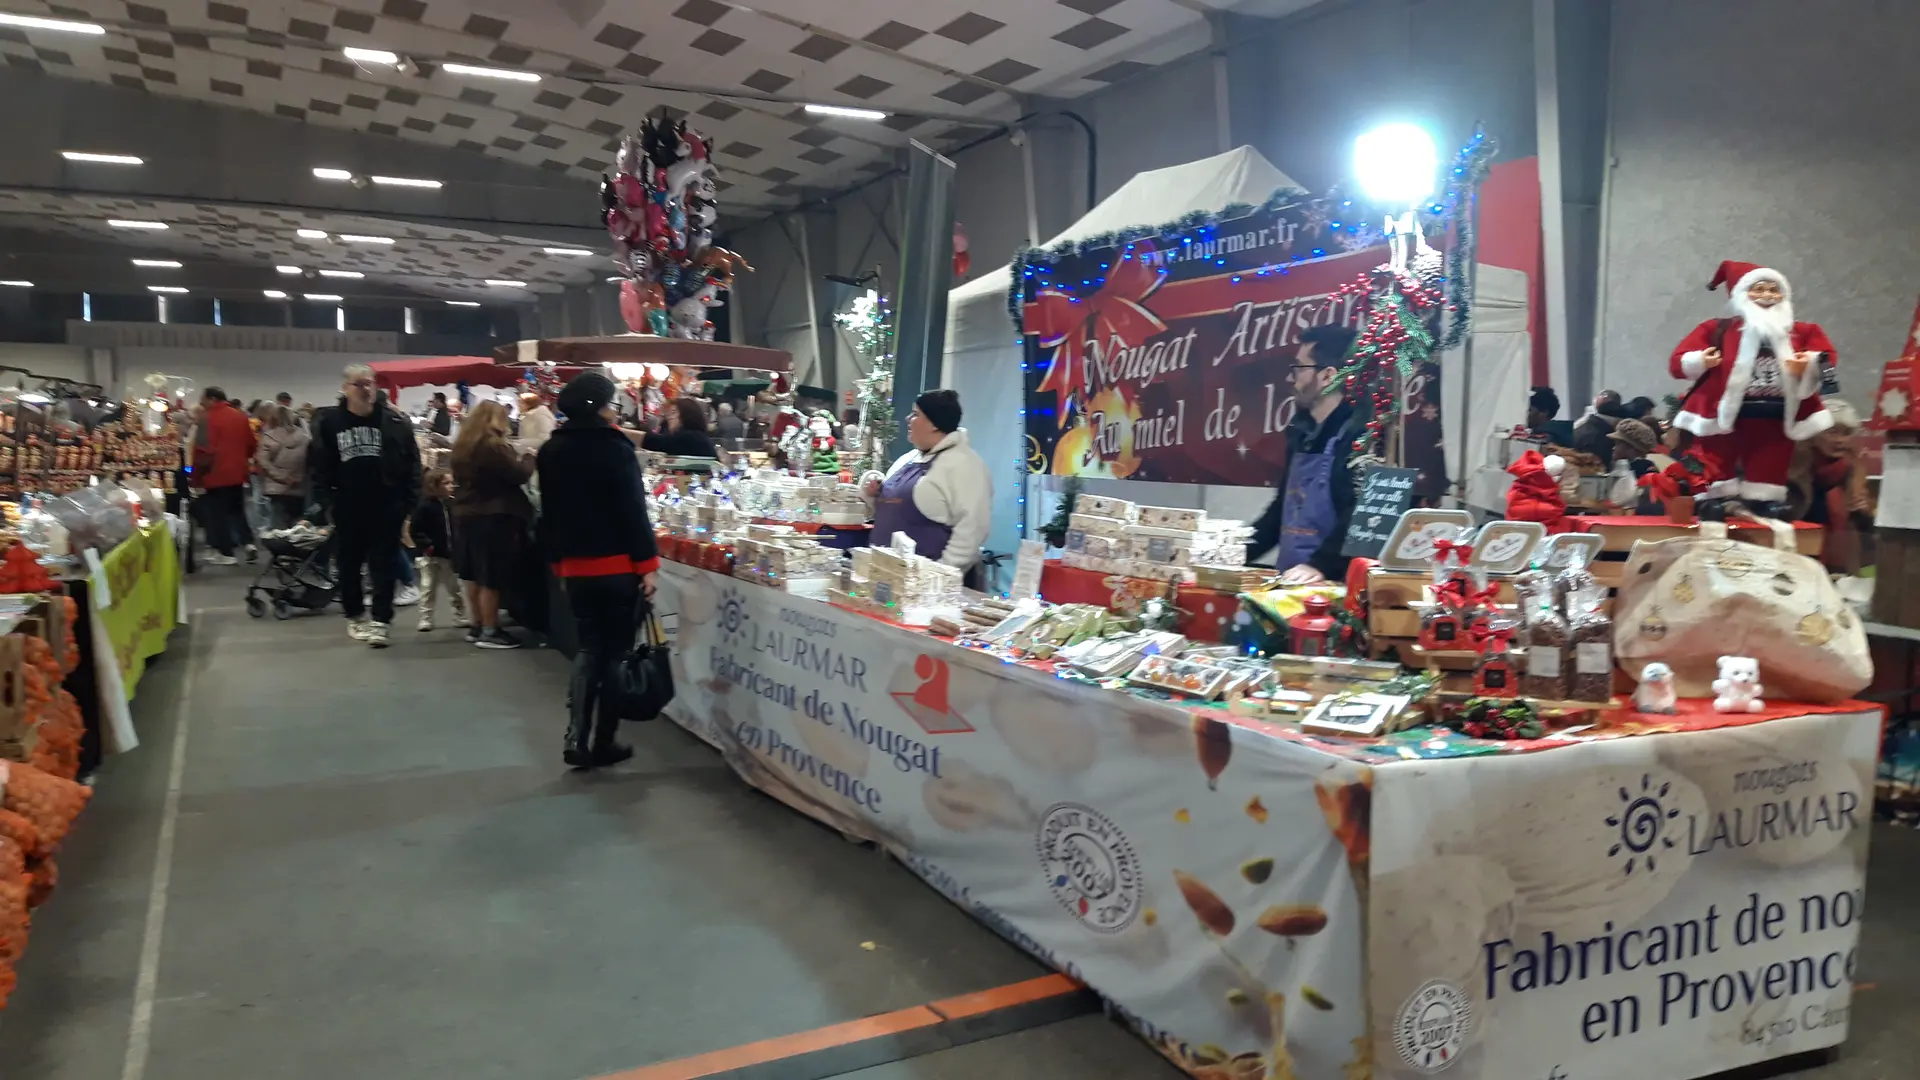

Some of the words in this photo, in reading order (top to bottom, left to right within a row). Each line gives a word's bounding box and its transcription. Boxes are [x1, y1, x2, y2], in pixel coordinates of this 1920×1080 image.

[1083, 327, 1198, 395] Nougat
[1082, 409, 1122, 467] Au
[1132, 400, 1185, 449] miel
[1204, 388, 1241, 442] de
[751, 622, 868, 693] LAURMAR
[710, 646, 798, 711] Fabricant
[803, 689, 834, 726] de
[840, 701, 943, 779] Nougat
[735, 720, 762, 749] en
[766, 727, 883, 814] Provence
[1687, 791, 1858, 855] LAURMAR
[1482, 903, 1721, 1001] Fabricant
[1735, 892, 1785, 947] de
[1582, 994, 1640, 1044] en
